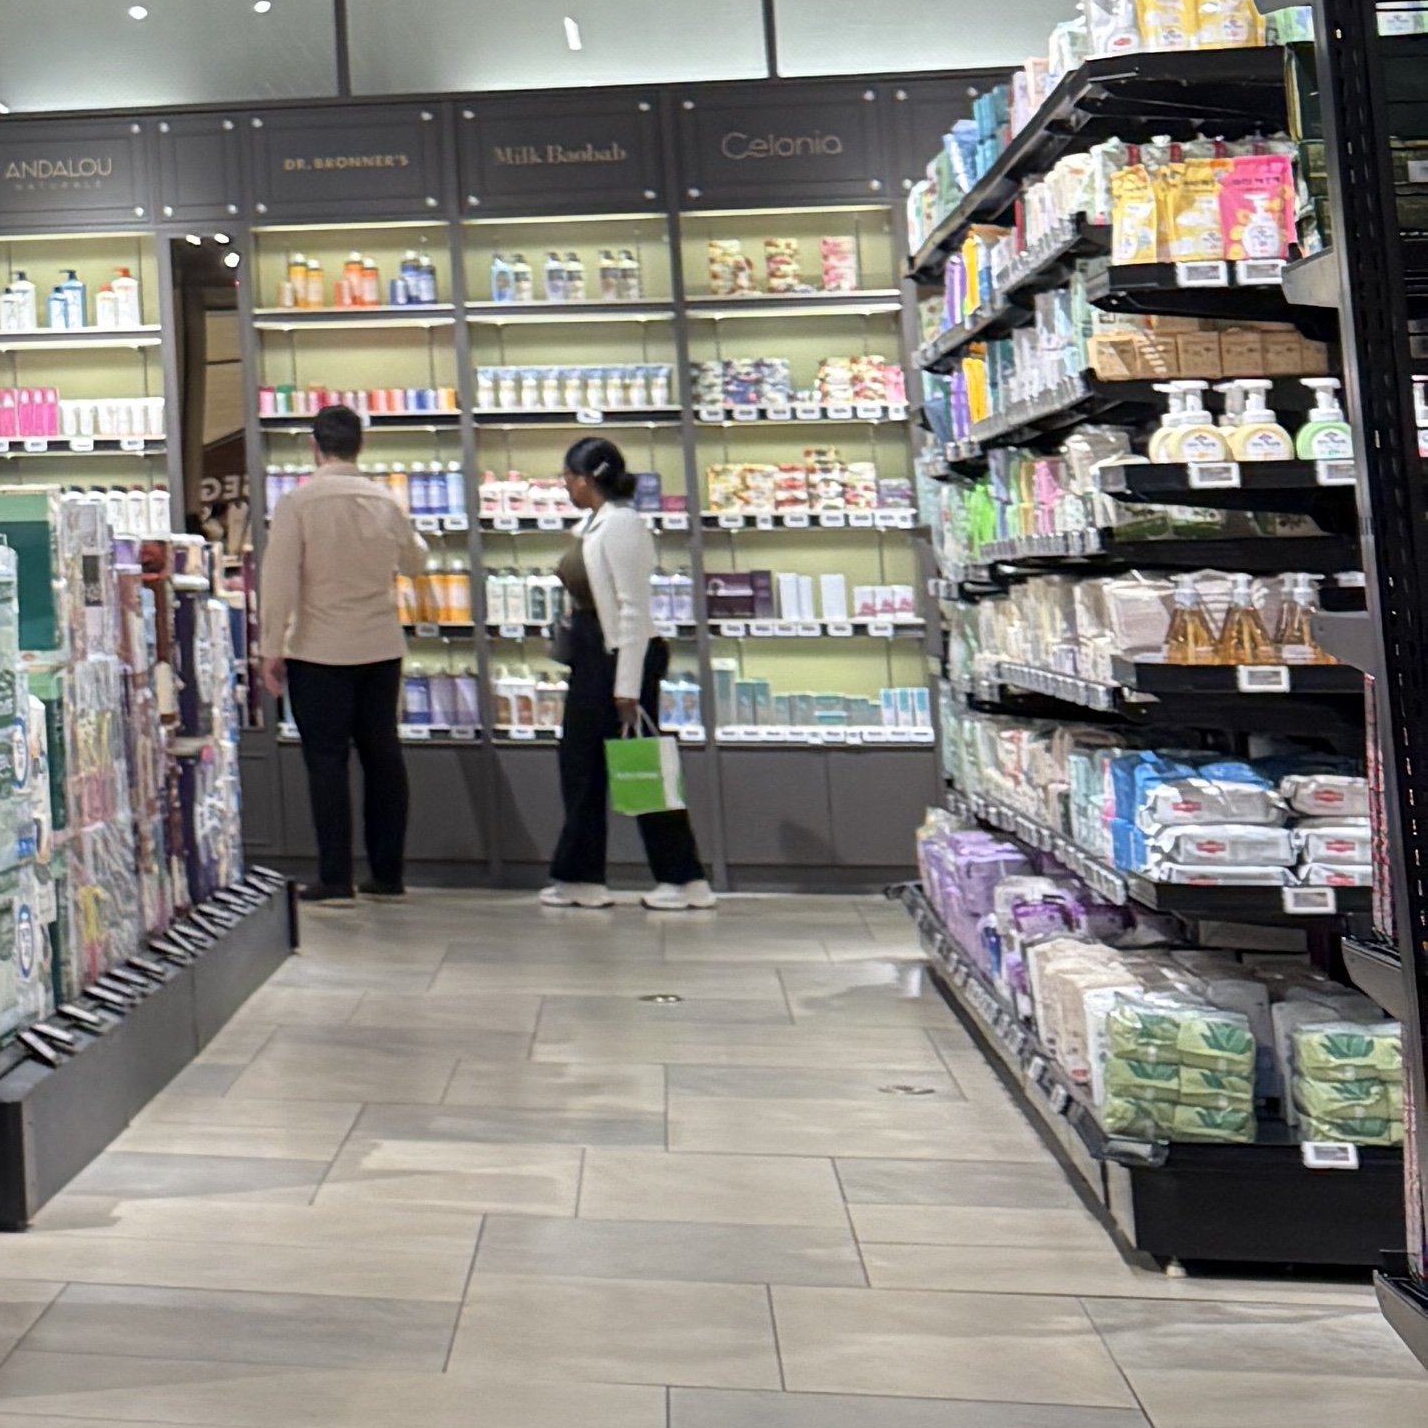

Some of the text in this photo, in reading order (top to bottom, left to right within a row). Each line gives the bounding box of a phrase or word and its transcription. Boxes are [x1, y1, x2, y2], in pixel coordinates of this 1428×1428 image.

[493, 142, 627, 166] Milk Baobab
[720, 131, 843, 160] Celonia
[4, 157, 113, 181] ANDALOU
[283, 153, 410, 172] DR. BRONNER'S
